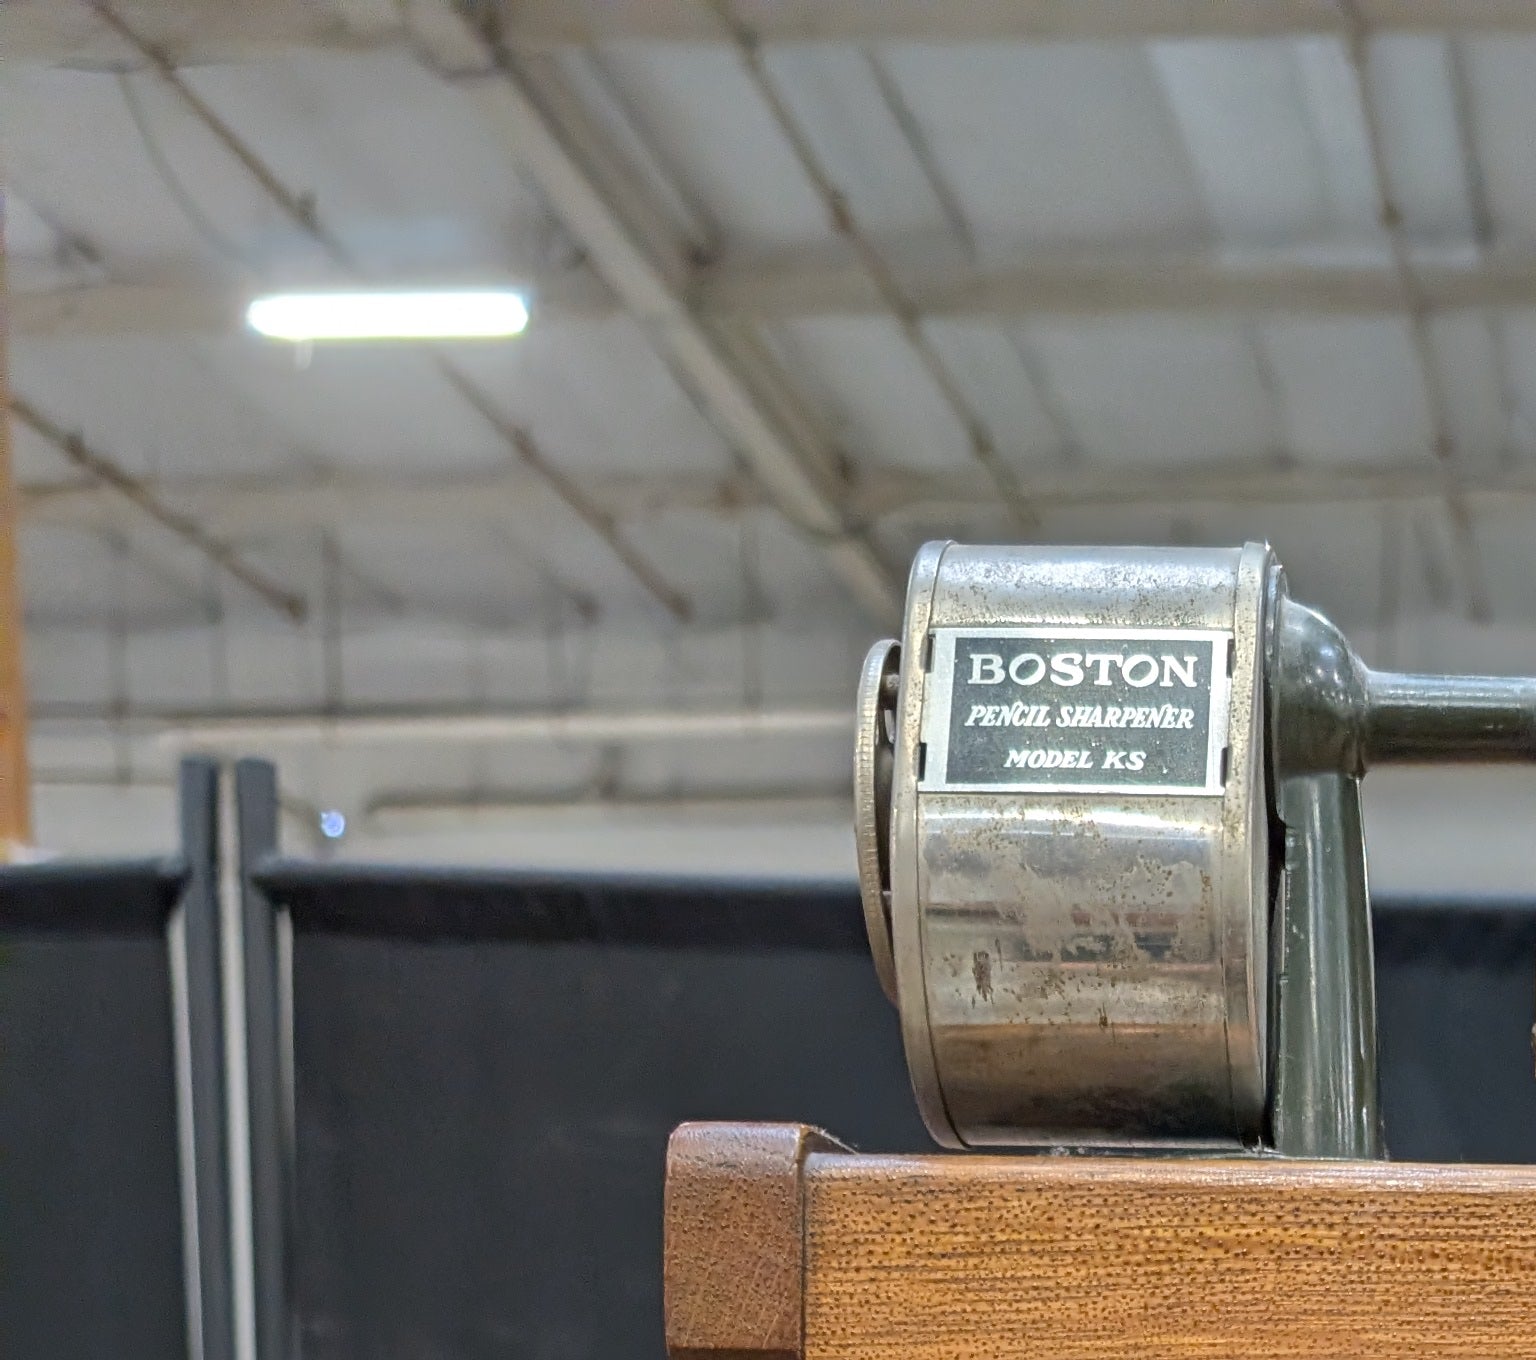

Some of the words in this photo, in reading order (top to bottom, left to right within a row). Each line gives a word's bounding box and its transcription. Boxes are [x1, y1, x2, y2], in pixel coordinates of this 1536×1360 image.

[967, 652, 1198, 688] BOSTON
[964, 702, 1053, 728] PENCIL
[1055, 703, 1195, 730] SHARPENER
[1002, 749, 1094, 770] MODEL
[1101, 751, 1147, 771] KS
